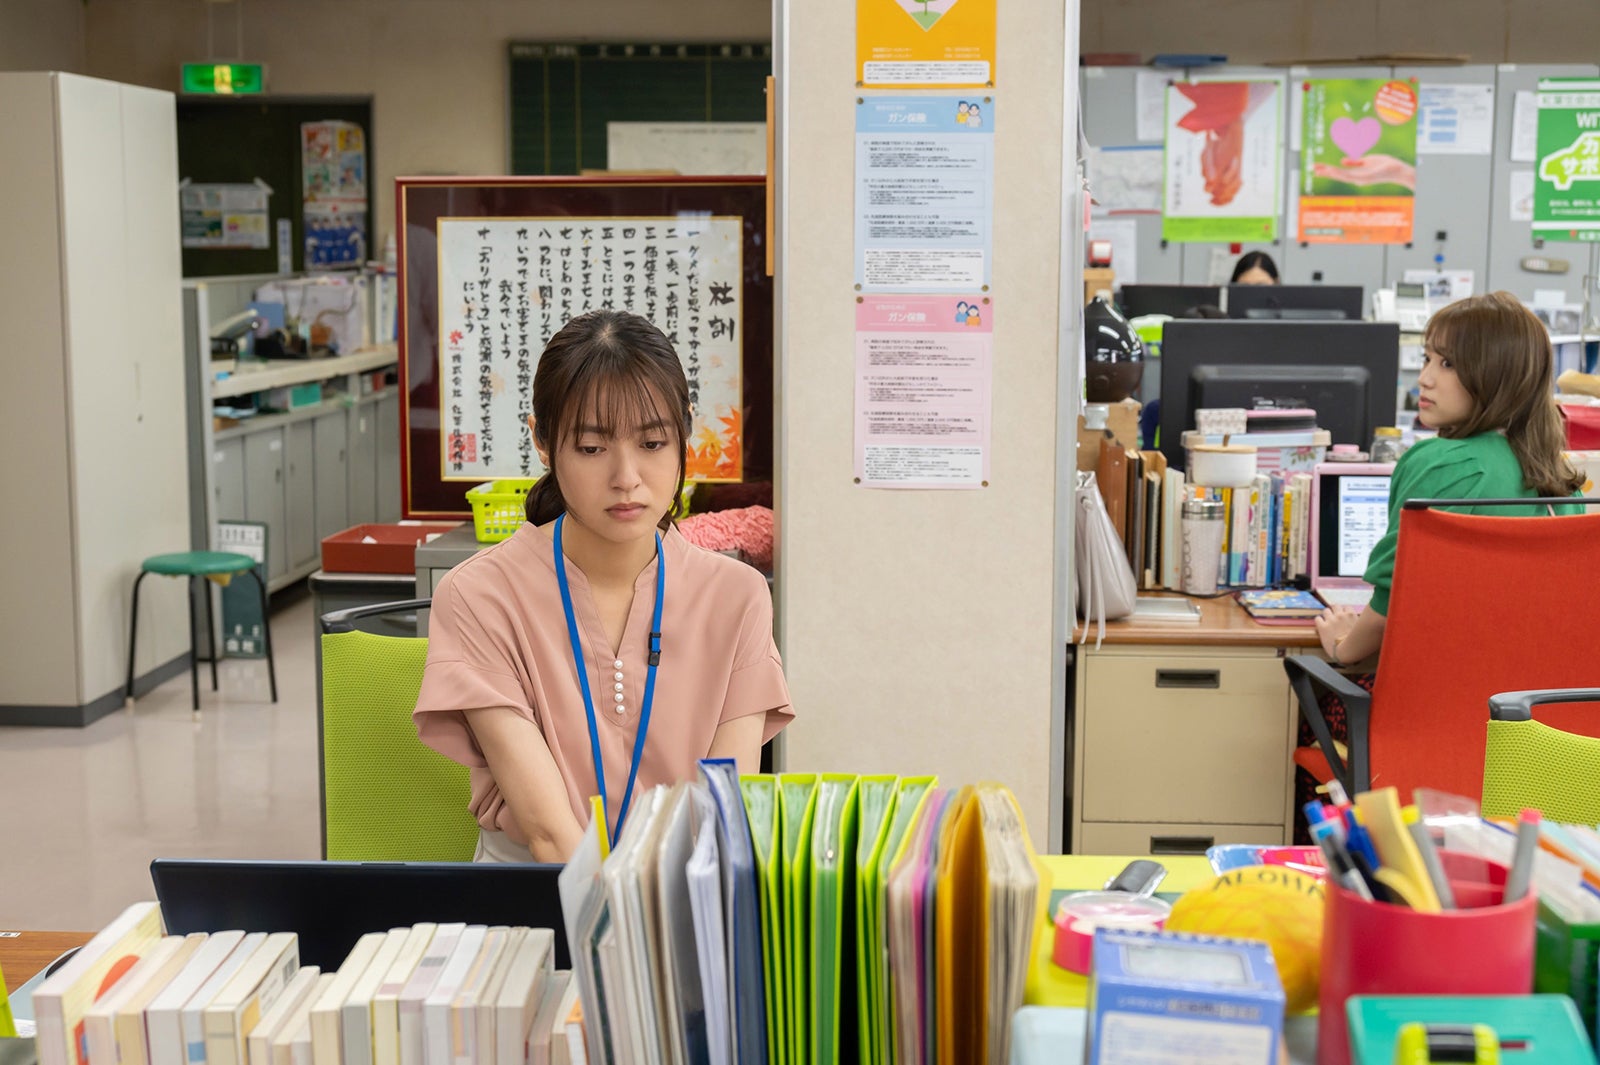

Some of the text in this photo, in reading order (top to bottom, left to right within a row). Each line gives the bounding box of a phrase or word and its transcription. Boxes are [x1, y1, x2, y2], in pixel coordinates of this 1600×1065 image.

[888, 112, 927, 123] ガン保険
[708, 281, 736, 342] 社訓
[888, 311, 927, 322] ガン保険
